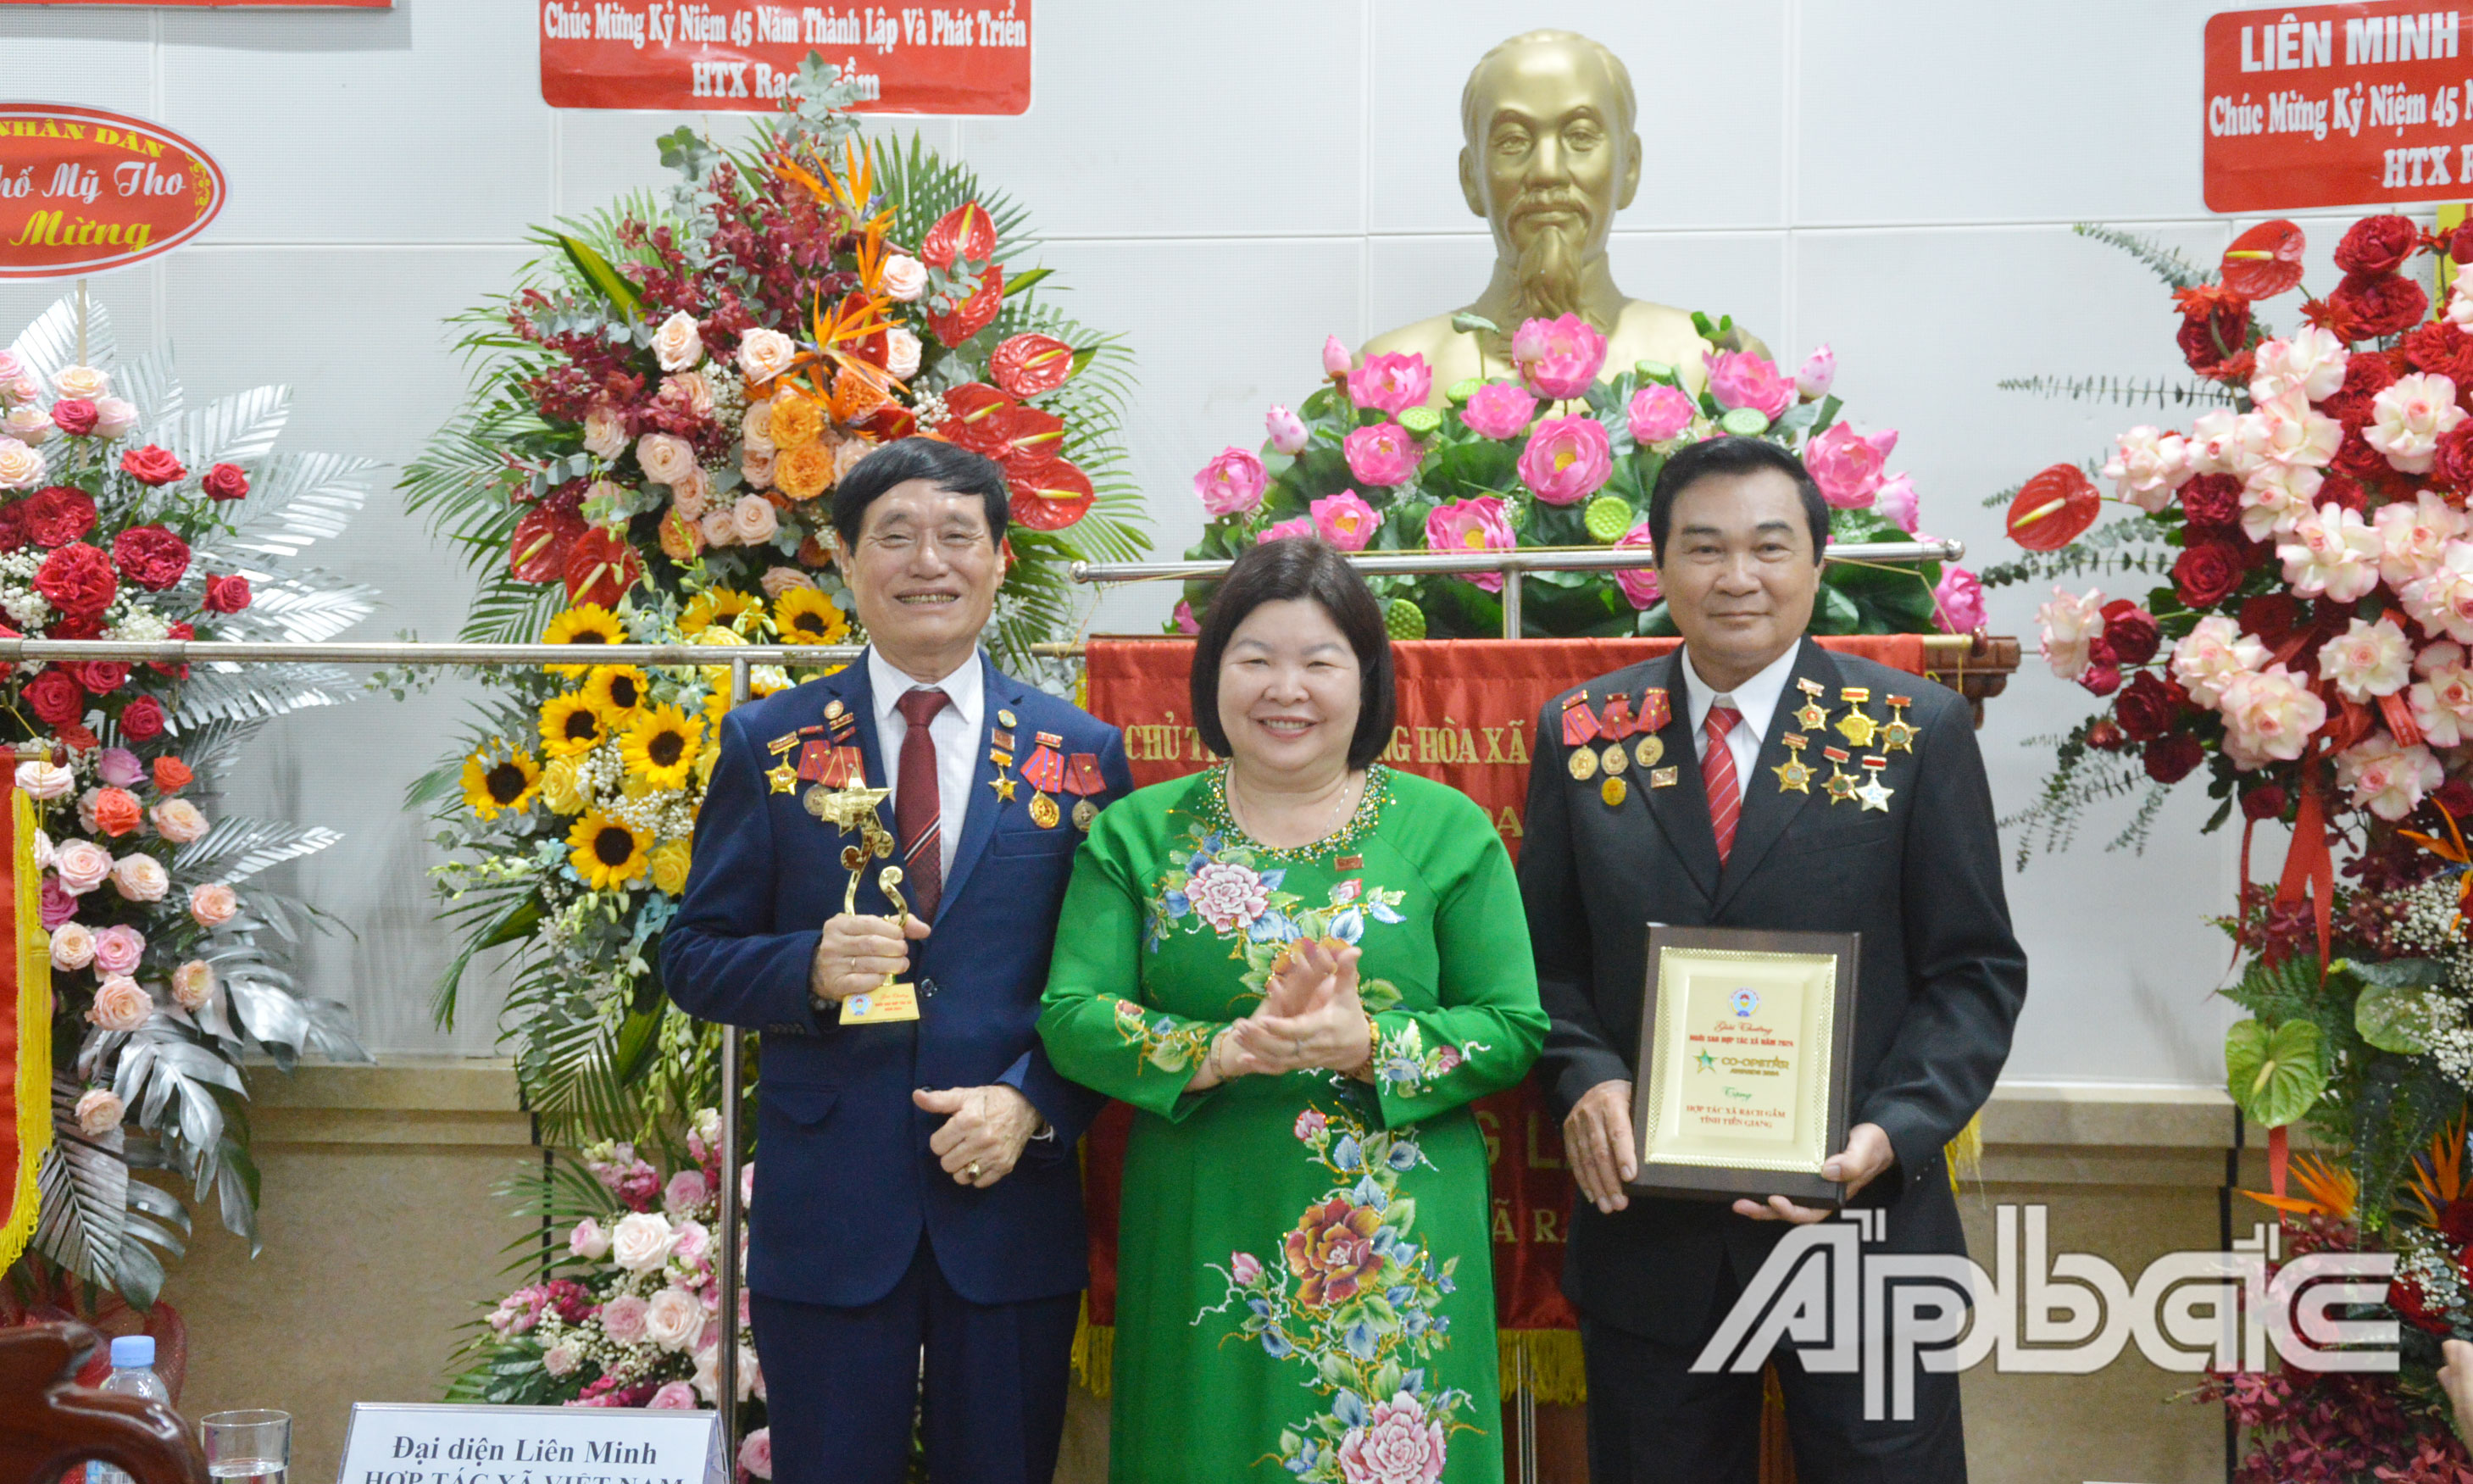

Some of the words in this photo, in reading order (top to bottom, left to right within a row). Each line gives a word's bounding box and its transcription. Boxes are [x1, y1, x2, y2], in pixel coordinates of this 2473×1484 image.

[544, 1, 591, 39] Chúc
[594, 2, 645, 49] Mừng
[648, 0, 675, 48] Kỷ
[680, 3, 726, 52] Niệm
[731, 9, 753, 47] 45
[757, 4, 798, 43] Năm
[803, 6, 860, 44] Thành
[864, 6, 898, 55] Lập
[902, 8, 927, 46] Và
[931, 8, 974, 47] Phát
[977, 0, 1026, 47] Triển
[2241, 13, 2331, 73] LIÊN
[2345, 10, 2459, 65] MINH
[692, 61, 749, 98] HTX
[2209, 92, 2264, 137] Chúc
[2268, 90, 2328, 141] Mừng
[2332, 81, 2365, 137] Kỷ
[2369, 81, 2426, 137] Niệm
[2431, 85, 2459, 127] 45
[94, 127, 166, 158] DÂN
[42, 163, 102, 204] Mỹ
[114, 161, 186, 197] Tho
[2382, 145, 2452, 188] HTX
[8, 210, 155, 253] Mừng
[1125, 711, 1182, 760] CHỦ
[1416, 716, 1480, 764] HÒA
[1483, 719, 1531, 764] XÃ
[392, 1436, 440, 1465] Đại
[447, 1437, 504, 1466] diện
[514, 1438, 575, 1462] Liên
[584, 1441, 657, 1465] Minh
